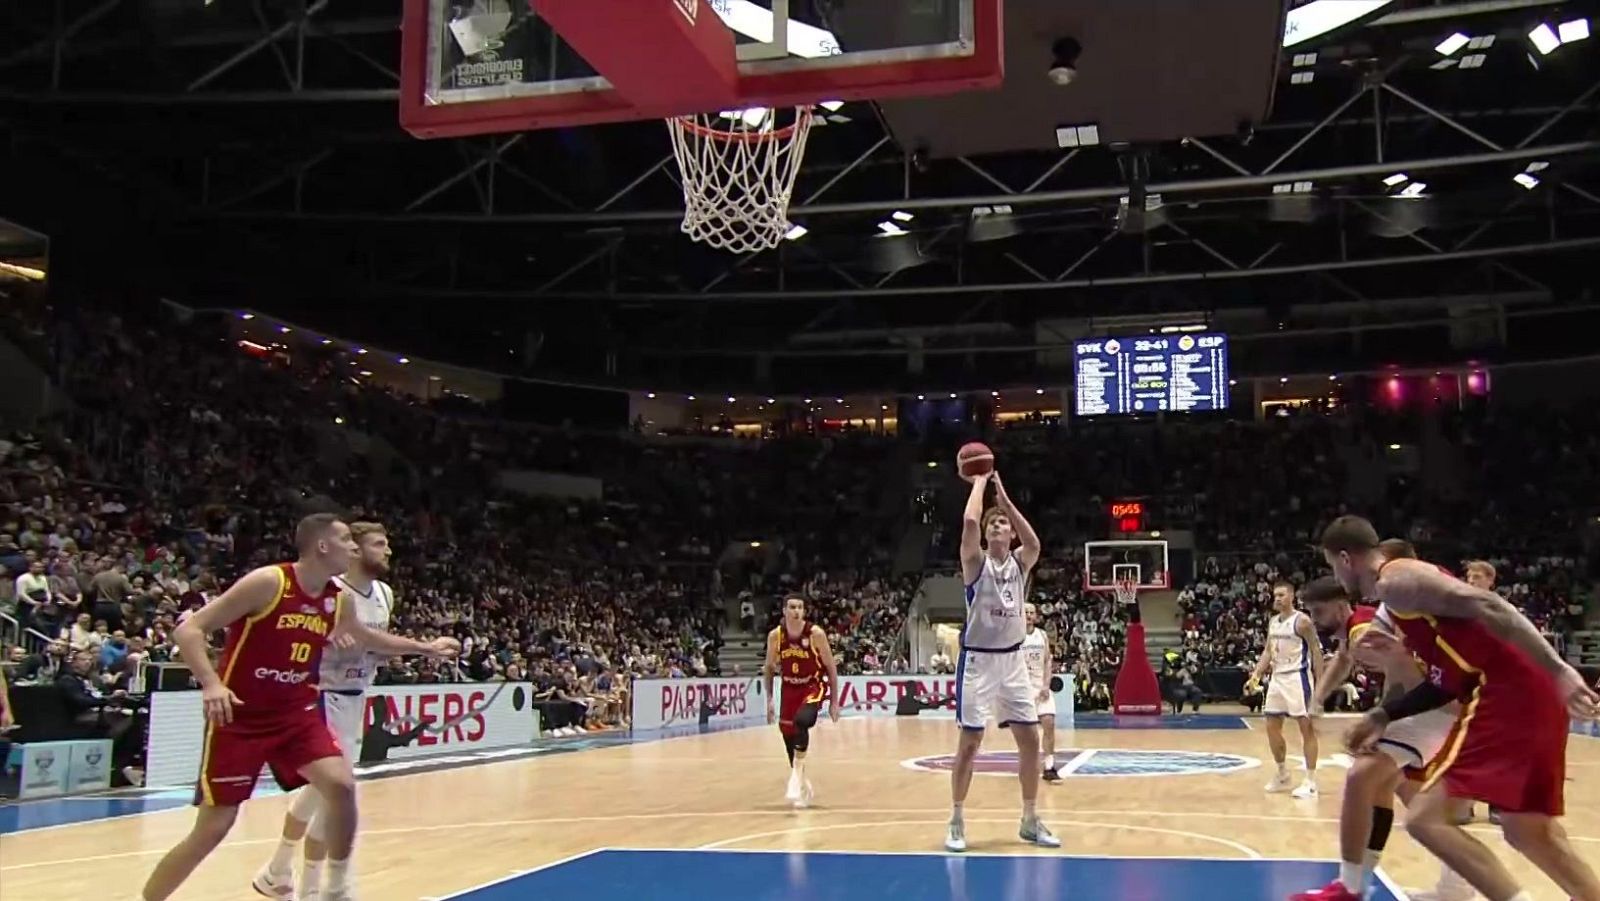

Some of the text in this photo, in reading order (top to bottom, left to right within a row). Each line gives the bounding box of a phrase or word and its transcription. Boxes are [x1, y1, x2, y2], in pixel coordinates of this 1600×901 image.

[1198, 336, 1224, 347] ESP
[1003, 590, 1013, 603] 3
[290, 642, 311, 663] 10
[662, 682, 746, 721] PARTNERS
